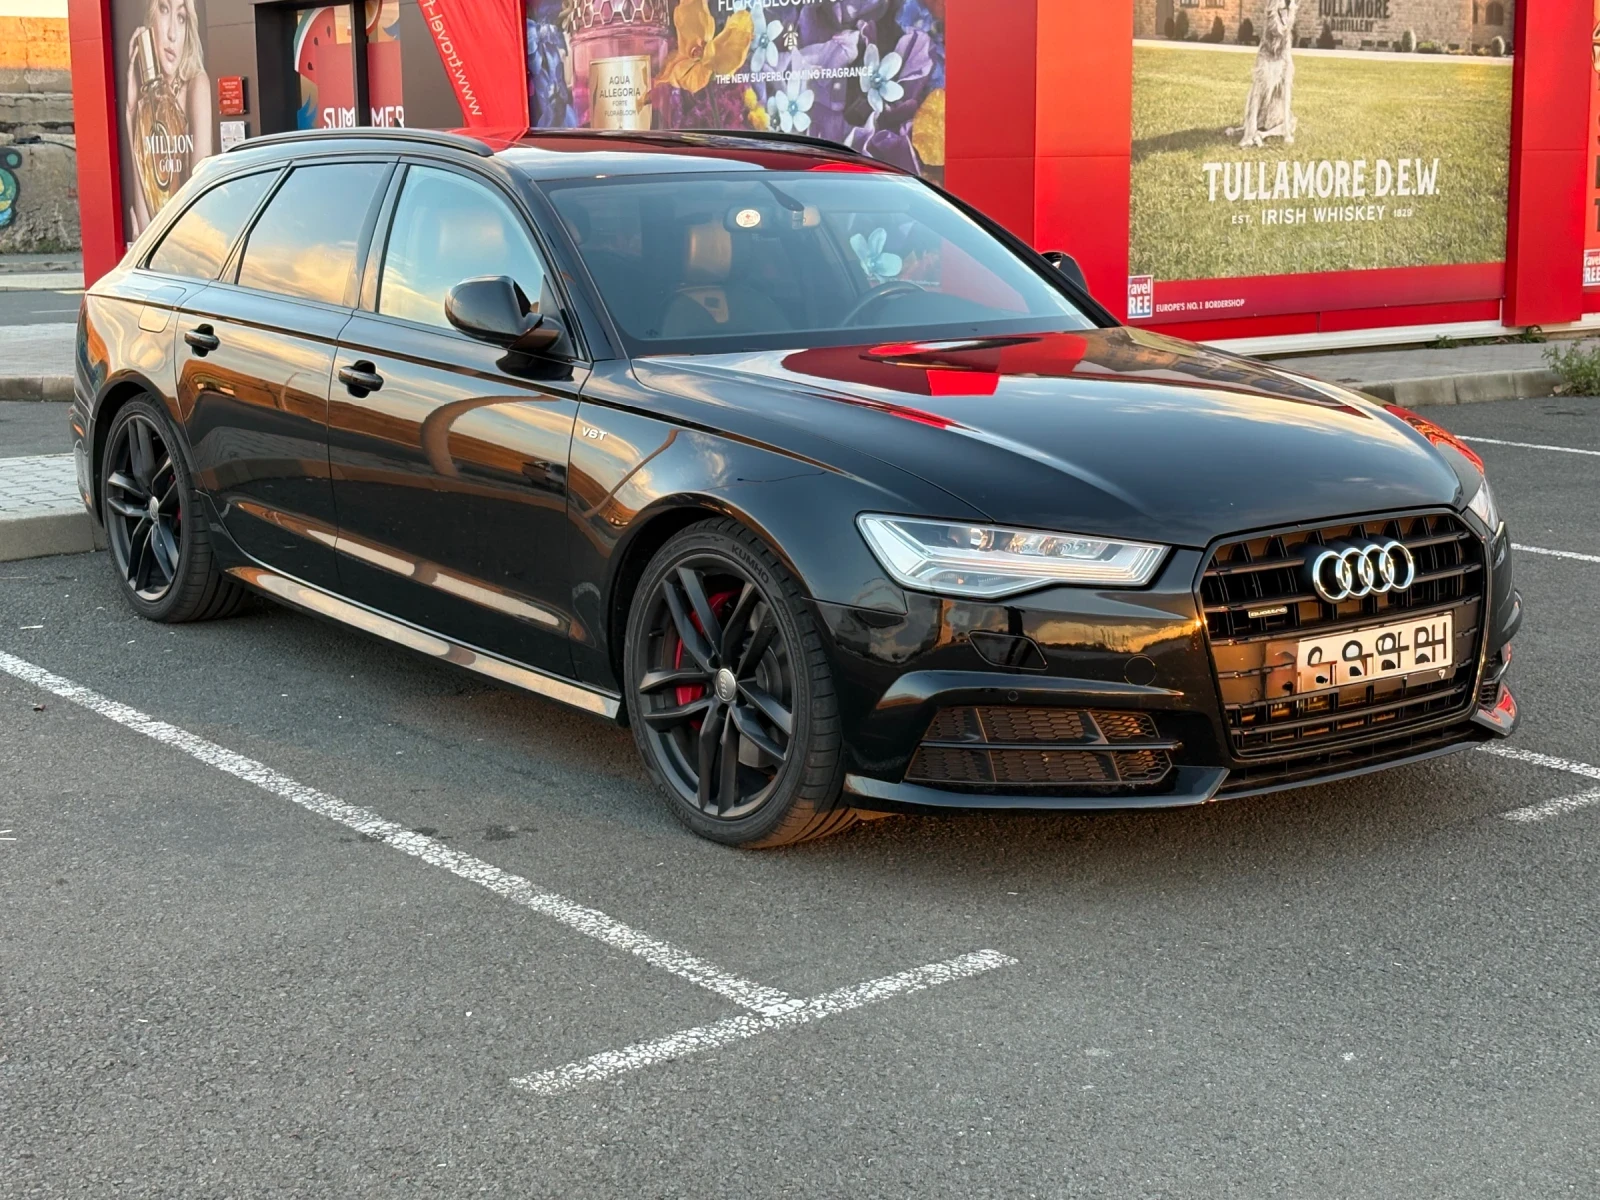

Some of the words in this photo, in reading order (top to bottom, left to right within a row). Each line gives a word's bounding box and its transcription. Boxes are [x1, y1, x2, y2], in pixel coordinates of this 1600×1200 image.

[718, 0, 813, 12] FLORAB
[609, 75, 631, 86] AQUA
[715, 74, 731, 85] THE
[731, 73, 749, 84] NEW
[750, 69, 821, 83] SUPERBLOOMING
[821, 66, 873, 80] FRAGRANCE
[599, 87, 641, 99] ALLEGORIA
[612, 99, 628, 107] FORTE
[145, 134, 194, 154] MILLION
[159, 159, 182, 173] GOLD
[1202, 159, 1367, 201] TULLAMORE
[1374, 157, 1440, 197] D.E.W.
[1231, 213, 1253, 225] EST.
[1261, 207, 1307, 225] IRISH
[1313, 204, 1386, 223] WHISKEY
[1128, 278, 1151, 295] ravel
[1128, 295, 1151, 315] REE
[1156, 302, 1186, 313] EUROPE'S
[1204, 298, 1245, 309] BORDERSHOP
[731, 543, 770, 584] KUMHO
